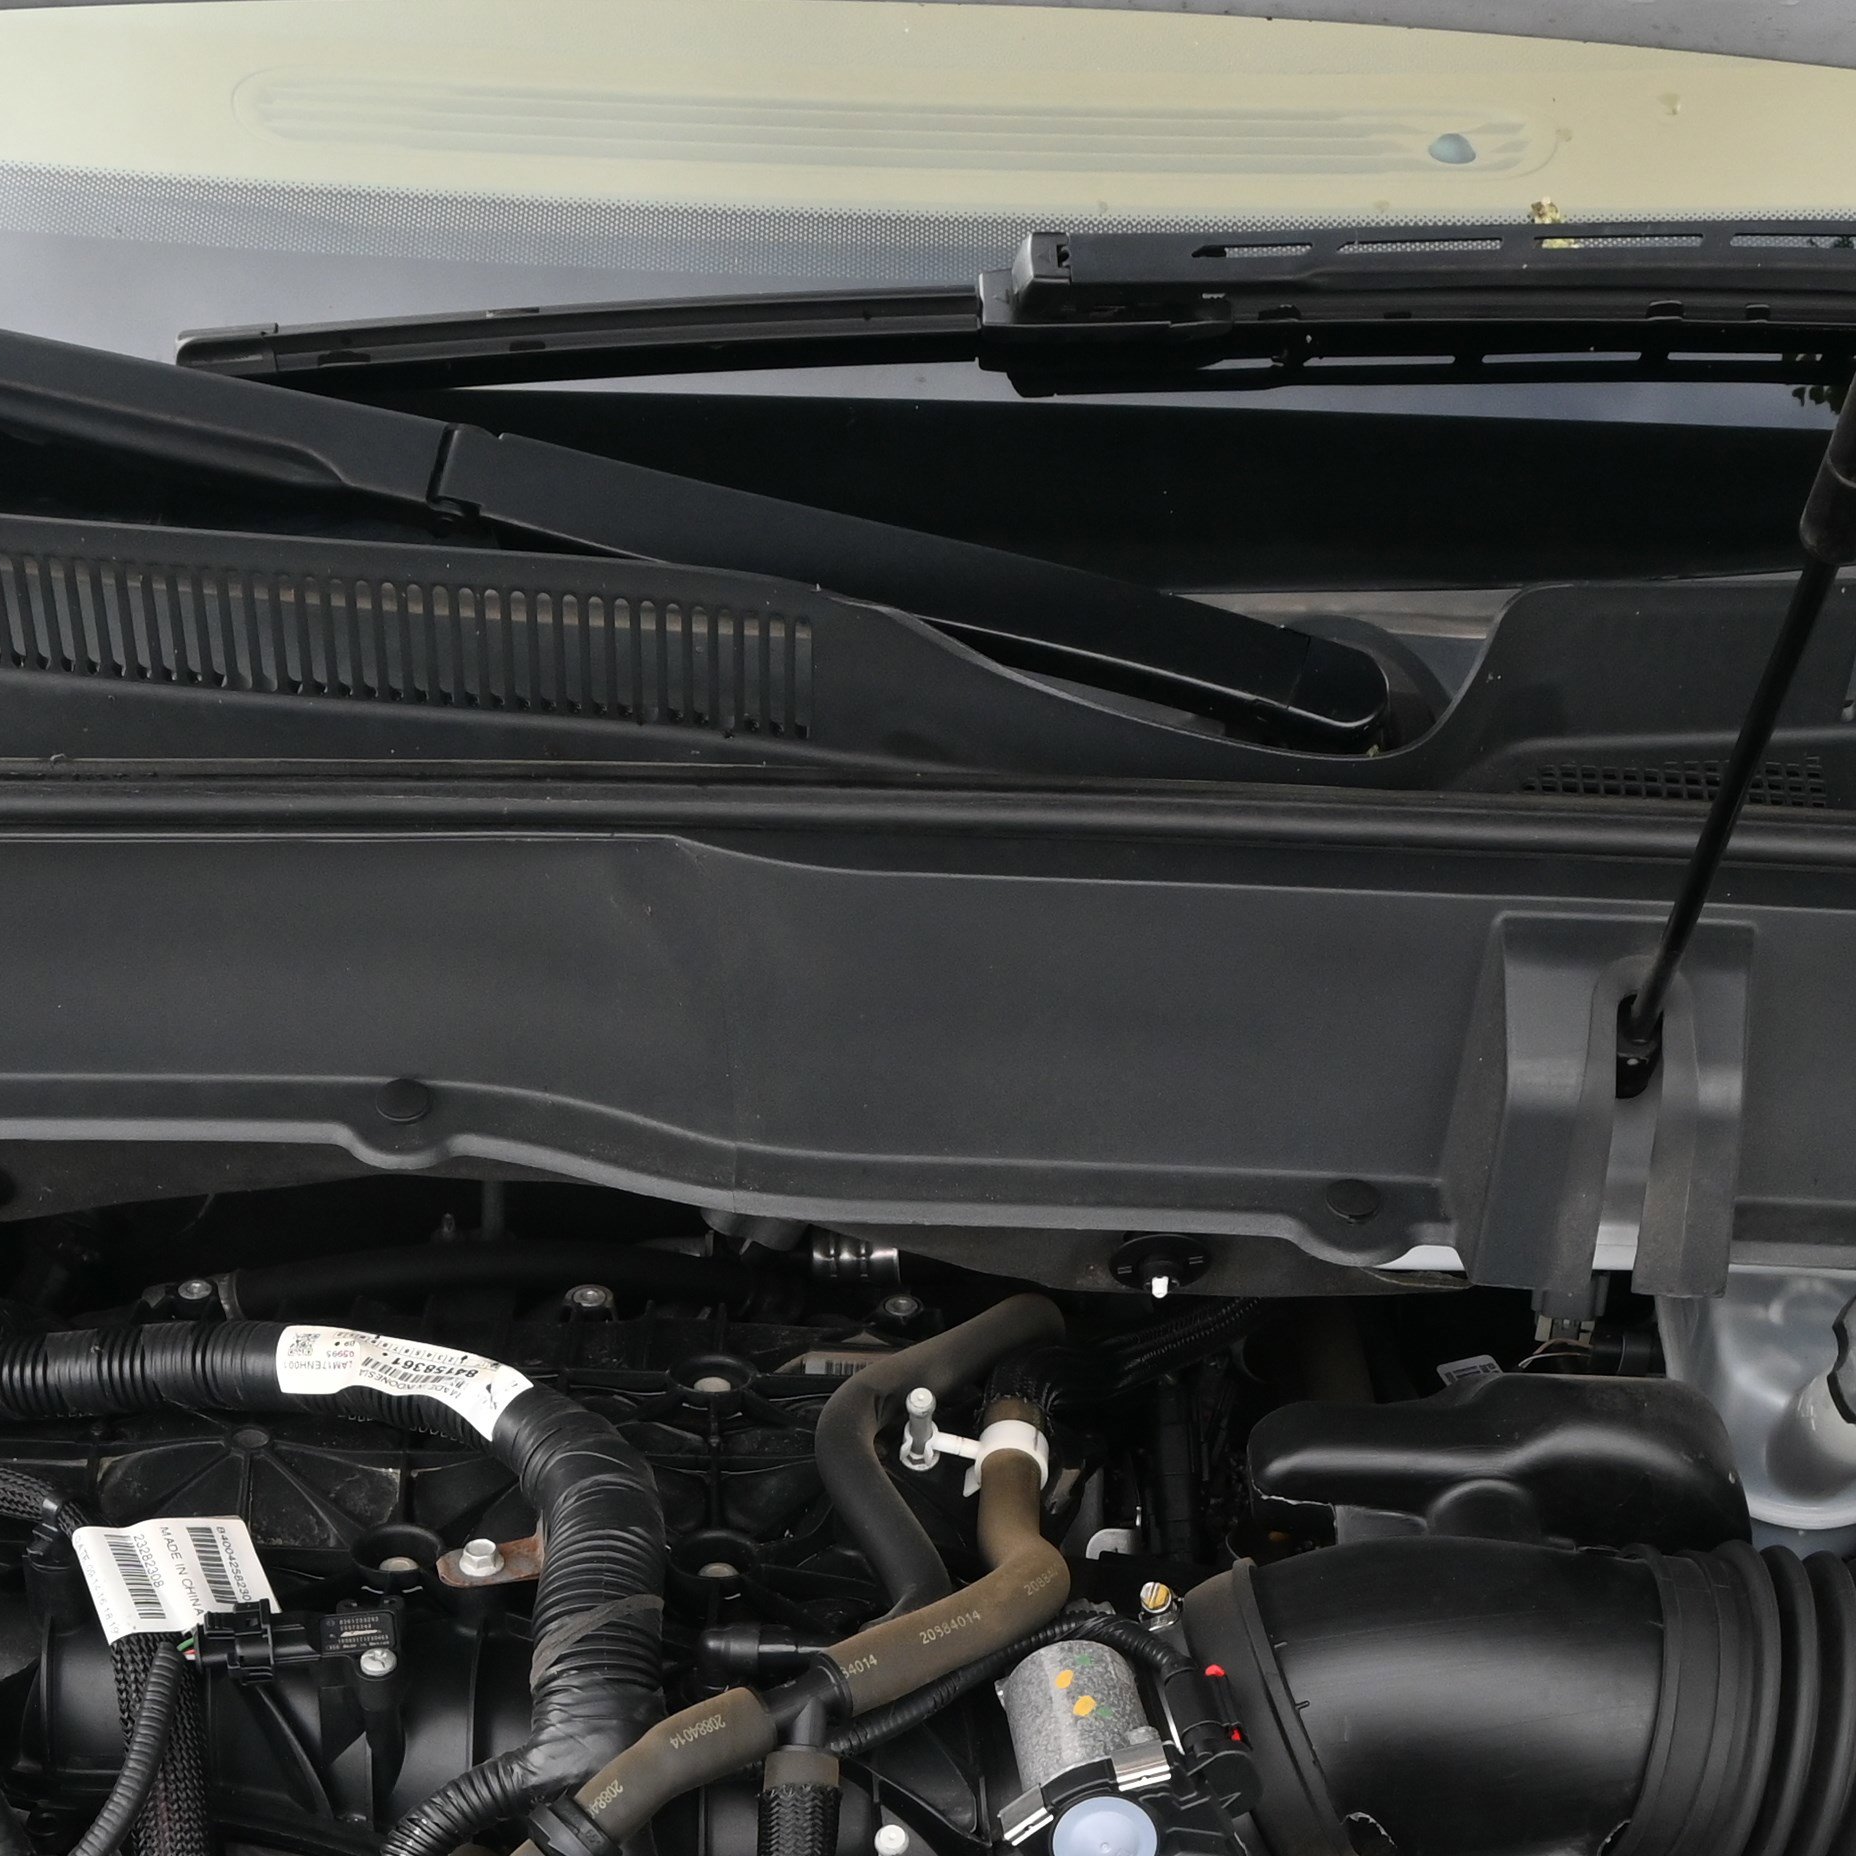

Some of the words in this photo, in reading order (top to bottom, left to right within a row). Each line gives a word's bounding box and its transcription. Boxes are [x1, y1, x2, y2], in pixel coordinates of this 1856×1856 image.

[391, 1357, 479, 1378] 84158361
[160, 1526, 182, 1559] MADE
[133, 1533, 165, 1588] 23282308
[176, 1563, 187, 1579] IN
[181, 1578, 205, 1617] CHINA
[669, 1714, 726, 1749] 20884014
